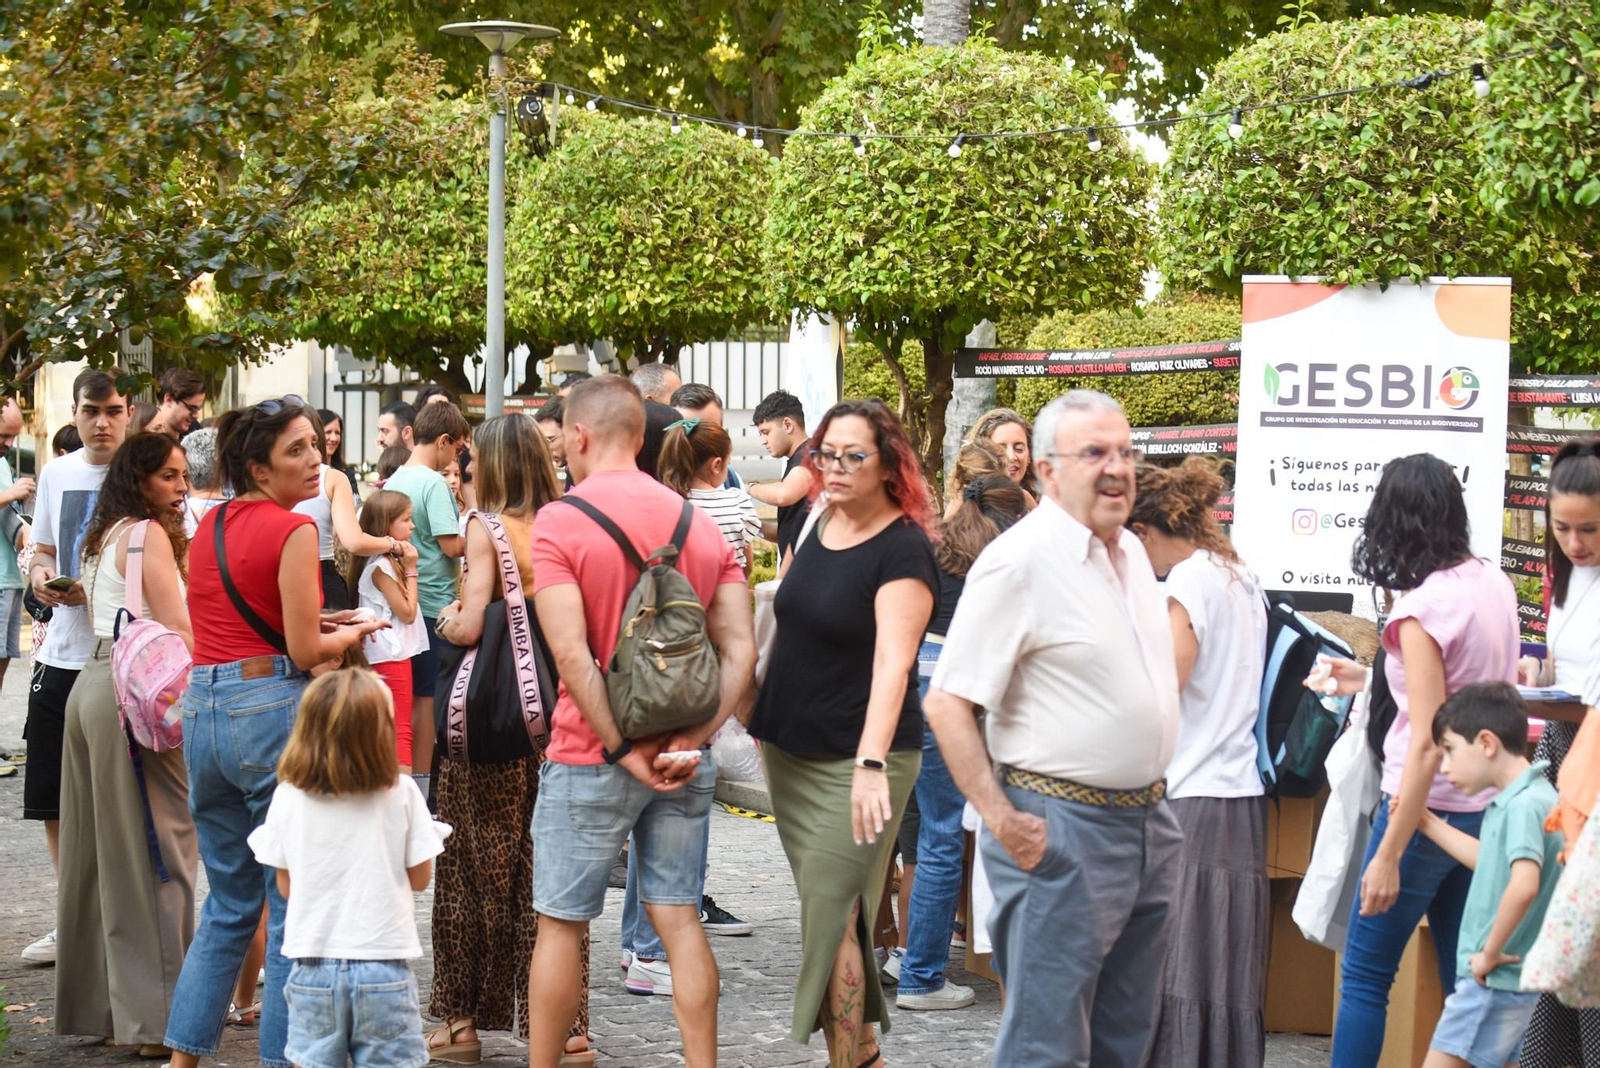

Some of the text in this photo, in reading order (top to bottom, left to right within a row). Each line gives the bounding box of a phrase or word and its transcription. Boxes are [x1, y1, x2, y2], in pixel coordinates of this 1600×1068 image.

[979, 352, 1000, 361] RAFAEL
[992, 364, 1025, 375] NAVARRETE
[1024, 364, 1045, 375] CALVO
[1048, 364, 1074, 374] ROSARIO
[1075, 363, 1104, 374] CASTILLO
[1131, 361, 1160, 372] ROSARIO
[1160, 360, 1174, 371] RUIZ
[1174, 359, 1208, 370] OLIVARES
[1264, 363, 1480, 410] GESBIO
[1543, 379, 1589, 388] GALLARDO
[1517, 391, 1568, 403] BUSTAMANTE
[1571, 392, 1595, 403] LUISA
[1295, 416, 1338, 424] INVESTIGACIÓN
[1348, 416, 1381, 425] EDUCACIÓN
[1388, 417, 1413, 425] GESTIÓN
[1431, 420, 1479, 428] BIODIVERSIDAD
[1517, 431, 1554, 442] JIMÉNEZ
[1147, 443, 1182, 455] BENLLOCH
[1182, 440, 1218, 454] GONZÁLEZ
[1354, 461, 1381, 476] par
[1291, 477, 1333, 492] todas
[1338, 479, 1360, 493] las
[1509, 480, 1549, 492] VON POL
[1508, 493, 1537, 506] PILAR
[1320, 512, 1366, 529] @Ges
[1282, 570, 1294, 584] O
[1300, 572, 1341, 585] visita
[501, 550, 518, 593] LOLA
[510, 605, 529, 660] BIMBA
[523, 680, 540, 723] LOLA
[453, 660, 472, 699] LOLA
